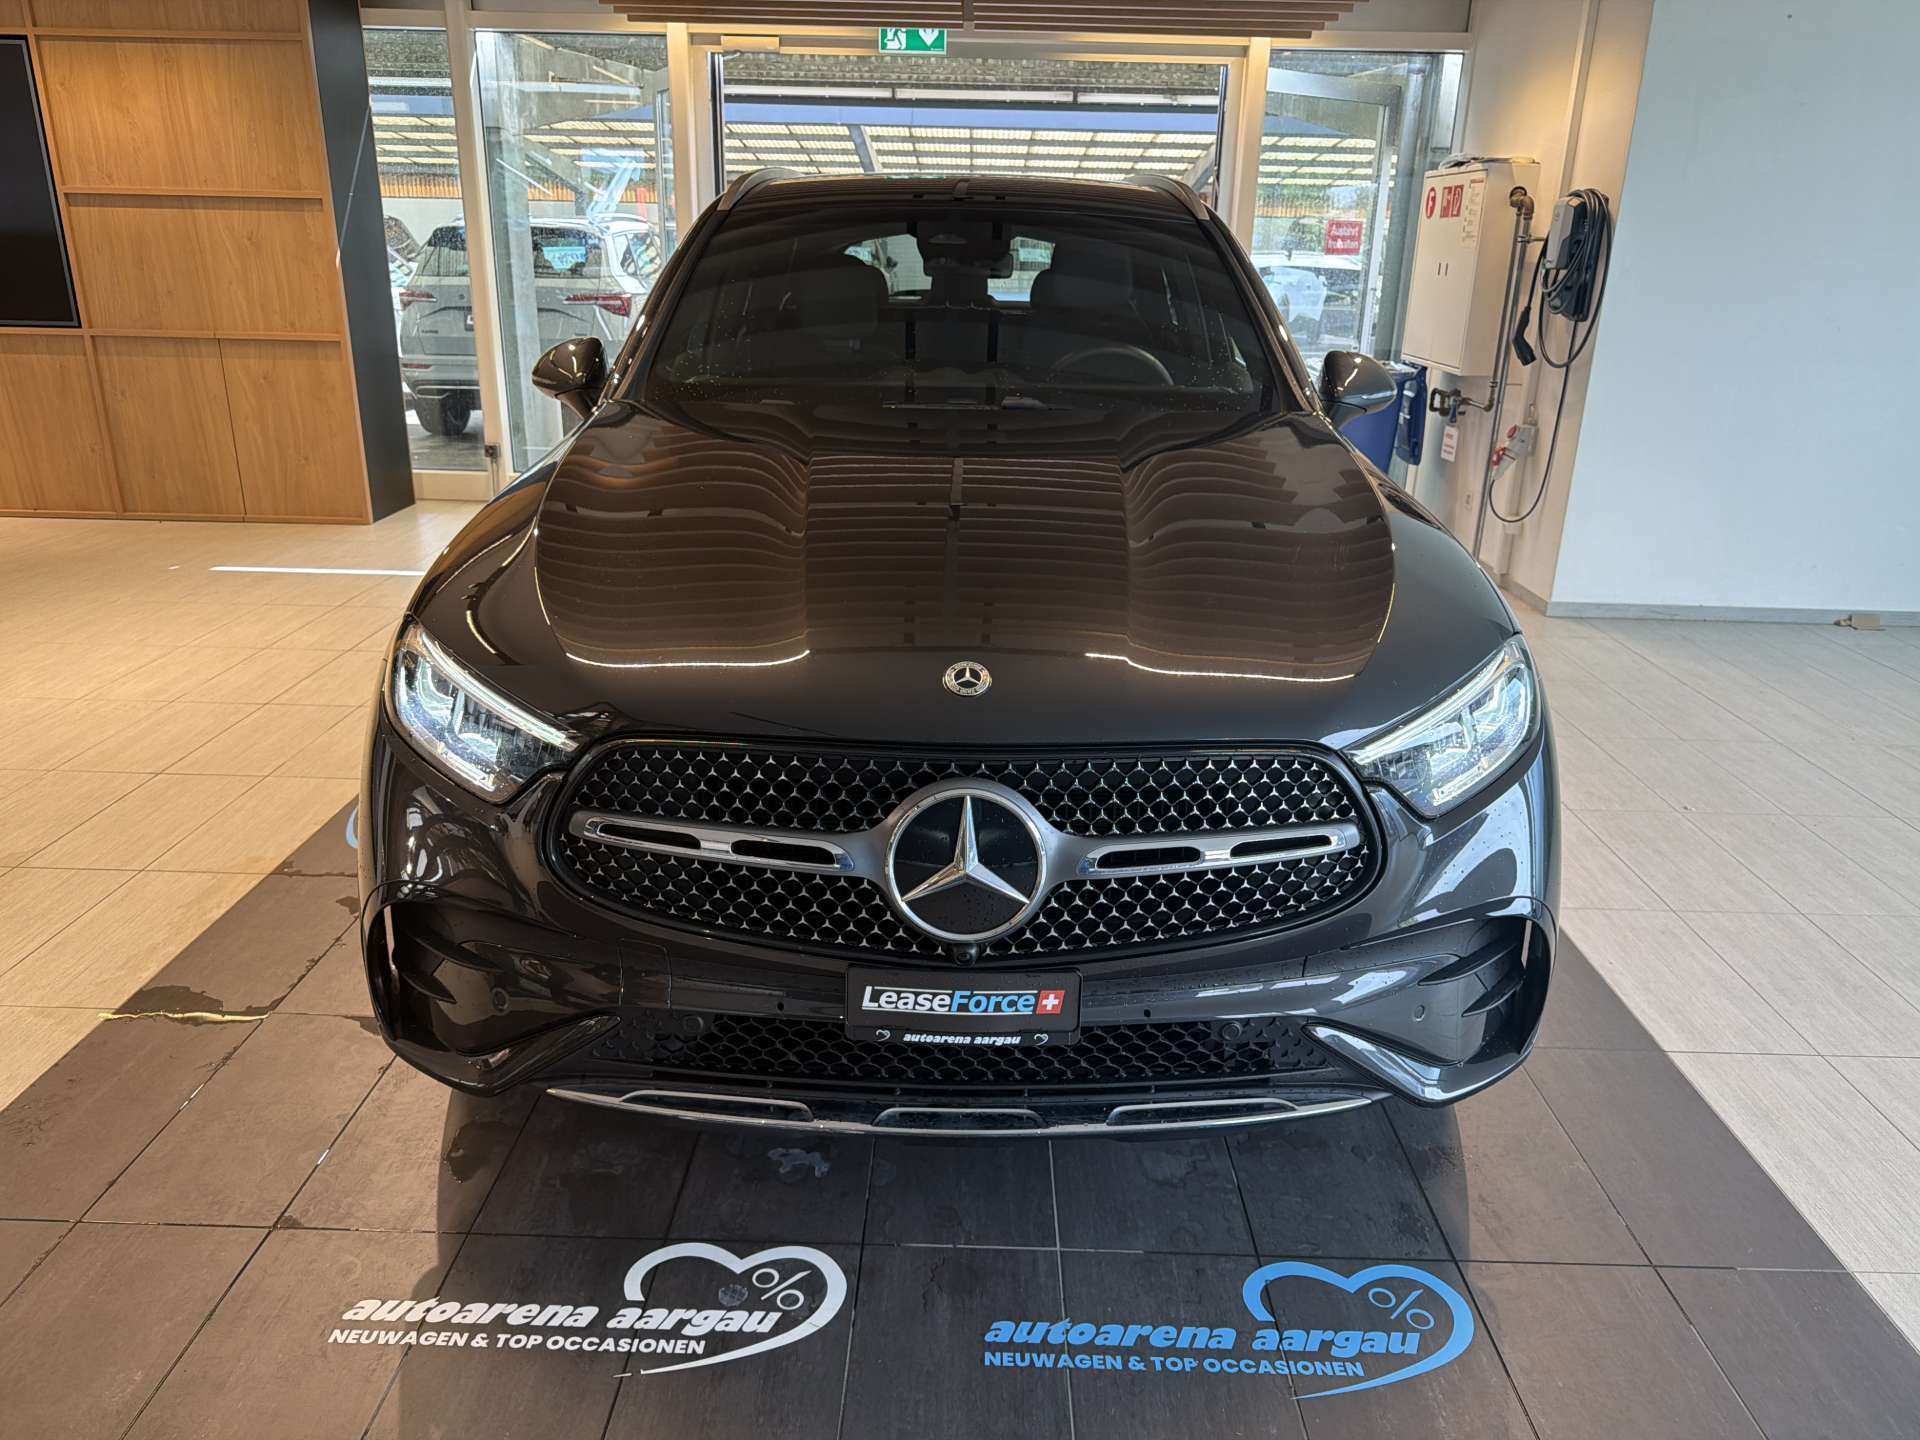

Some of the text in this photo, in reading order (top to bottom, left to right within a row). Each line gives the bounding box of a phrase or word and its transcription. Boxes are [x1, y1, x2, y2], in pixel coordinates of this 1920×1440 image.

[862, 986, 1036, 1014] LeaseForce
[903, 1032, 1021, 1046] autoarena aargau
[342, 1296, 783, 1336] autoarena aargau
[327, 1328, 706, 1355] NEUWAGEN & TOP OCCASIONEN
[984, 1318, 1421, 1359] autoarena aargau
[984, 1351, 1365, 1377] NEUWAGEN & TOP OCCASIONEN
